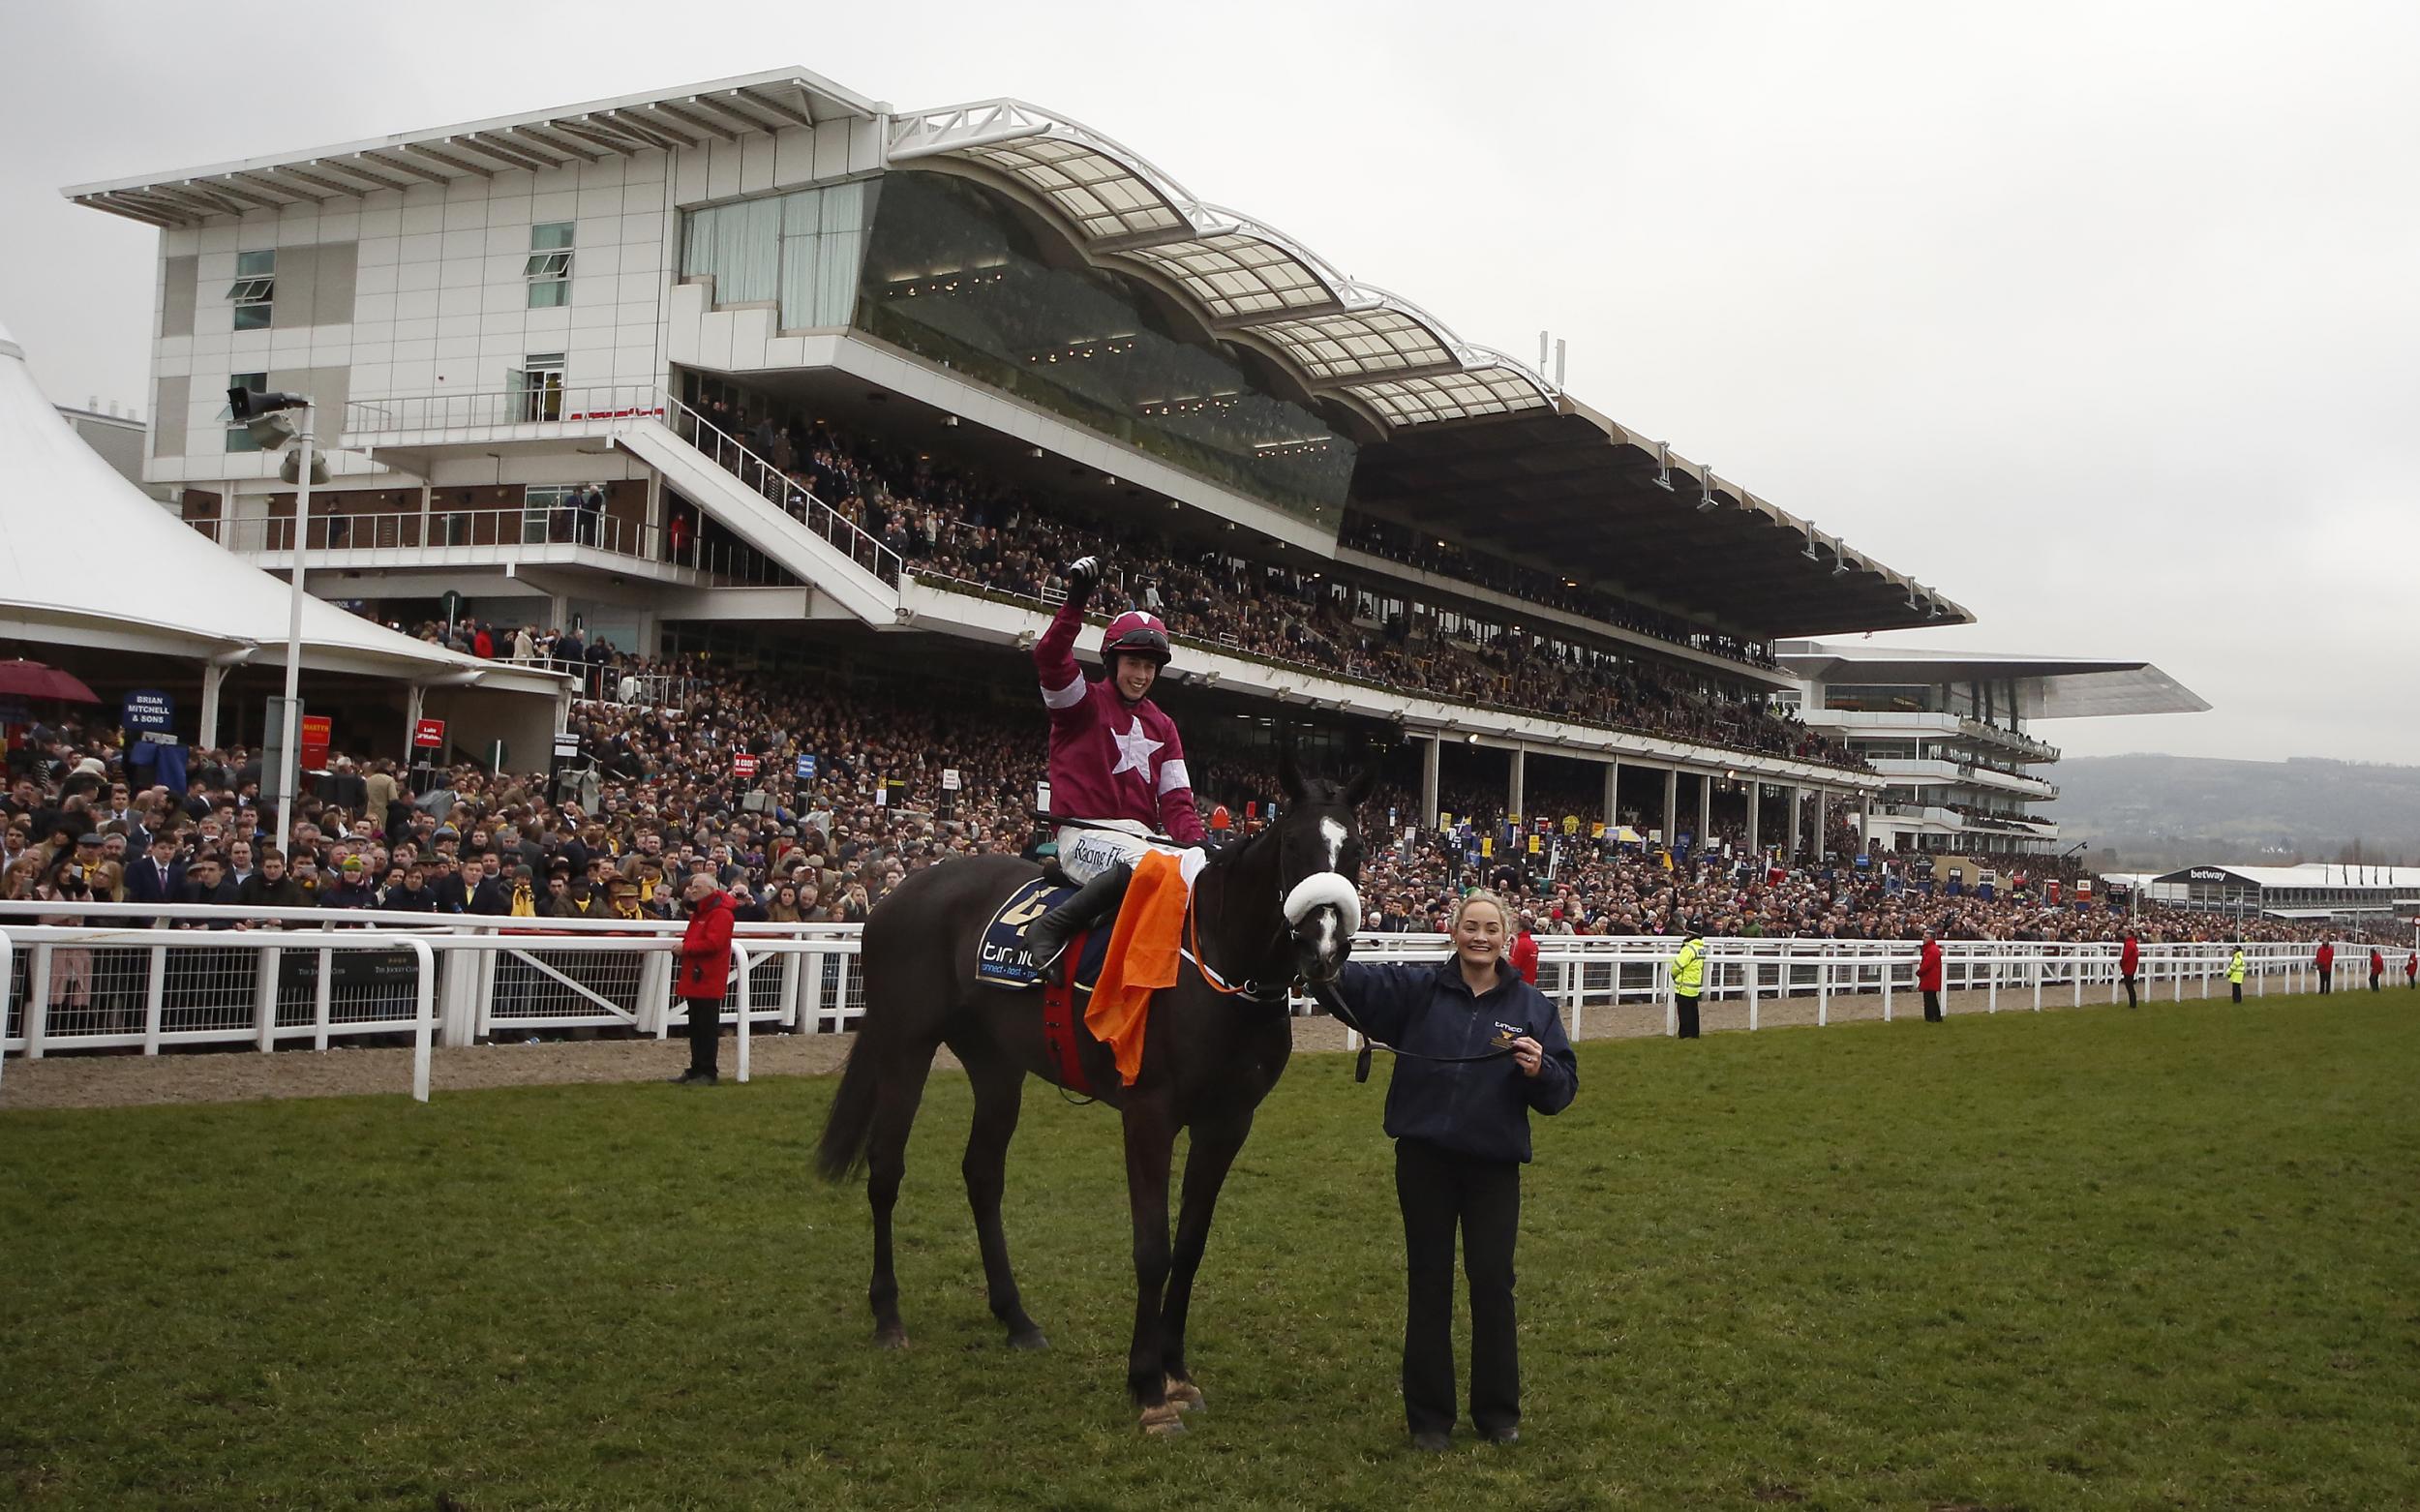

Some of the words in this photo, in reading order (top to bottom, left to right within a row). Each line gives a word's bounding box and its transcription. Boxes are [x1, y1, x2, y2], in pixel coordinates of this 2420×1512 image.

[136, 696, 164, 705] BRIAN
[128, 705, 169, 714] MITCHELL
[2191, 869, 2226, 882] betway
[999, 886, 1060, 937] 4
[1495, 1021, 1523, 1033] timico
